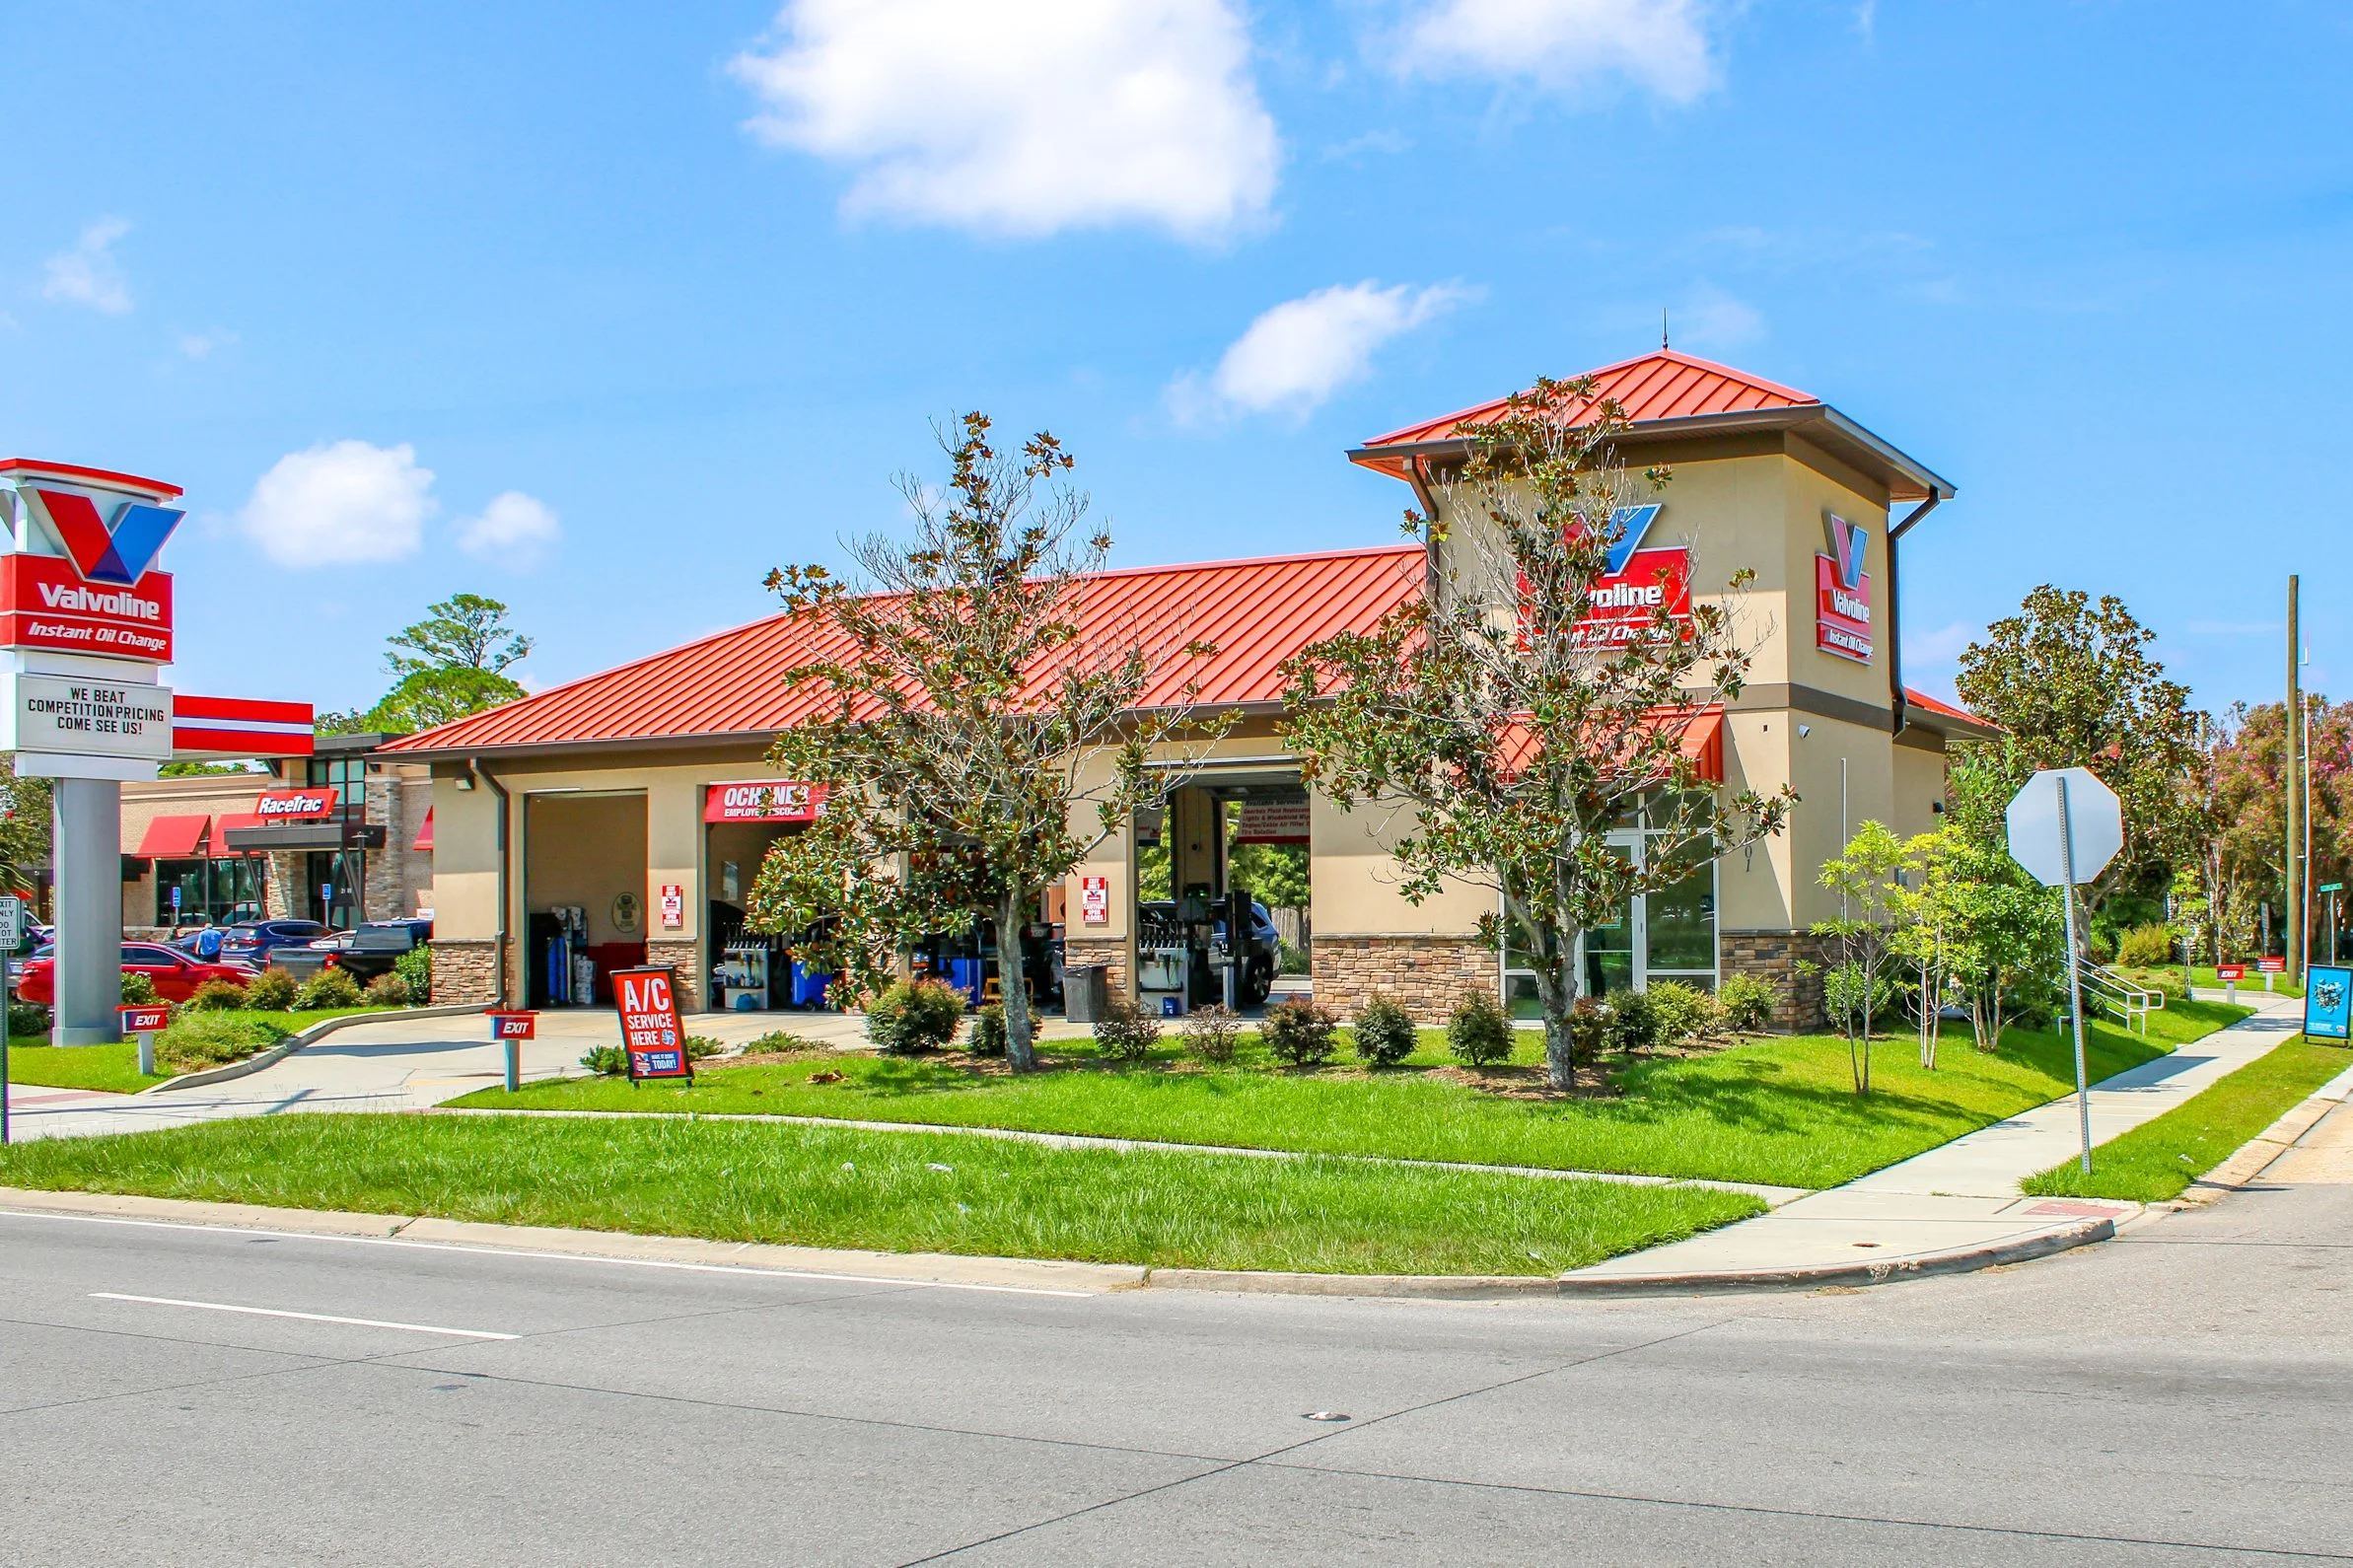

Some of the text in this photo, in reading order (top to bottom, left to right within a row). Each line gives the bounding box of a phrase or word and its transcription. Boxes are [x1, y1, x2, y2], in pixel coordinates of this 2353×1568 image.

[36, 582, 161, 620] Valvoline
[1832, 589, 1870, 623] Valvoline
[28, 621, 167, 651] Instant Oil Change
[1829, 628, 1849, 648] Instant
[70, 686, 126, 704] WE BEAT
[28, 698, 165, 722] COMPETITION PRICING
[57, 716, 143, 735] COME SEE US!
[257, 795, 323, 815] RaceTrac
[724, 784, 811, 808] OCHNE
[724, 807, 764, 818] EMPLOYE
[623, 977, 670, 1013] A/C
[134, 1014, 161, 1027] EXIT
[502, 1022, 530, 1034] EXIT
[626, 1013, 675, 1030] SERVICE
[629, 1031, 661, 1046] HERE
[651, 1058, 677, 1070] TODAY!
